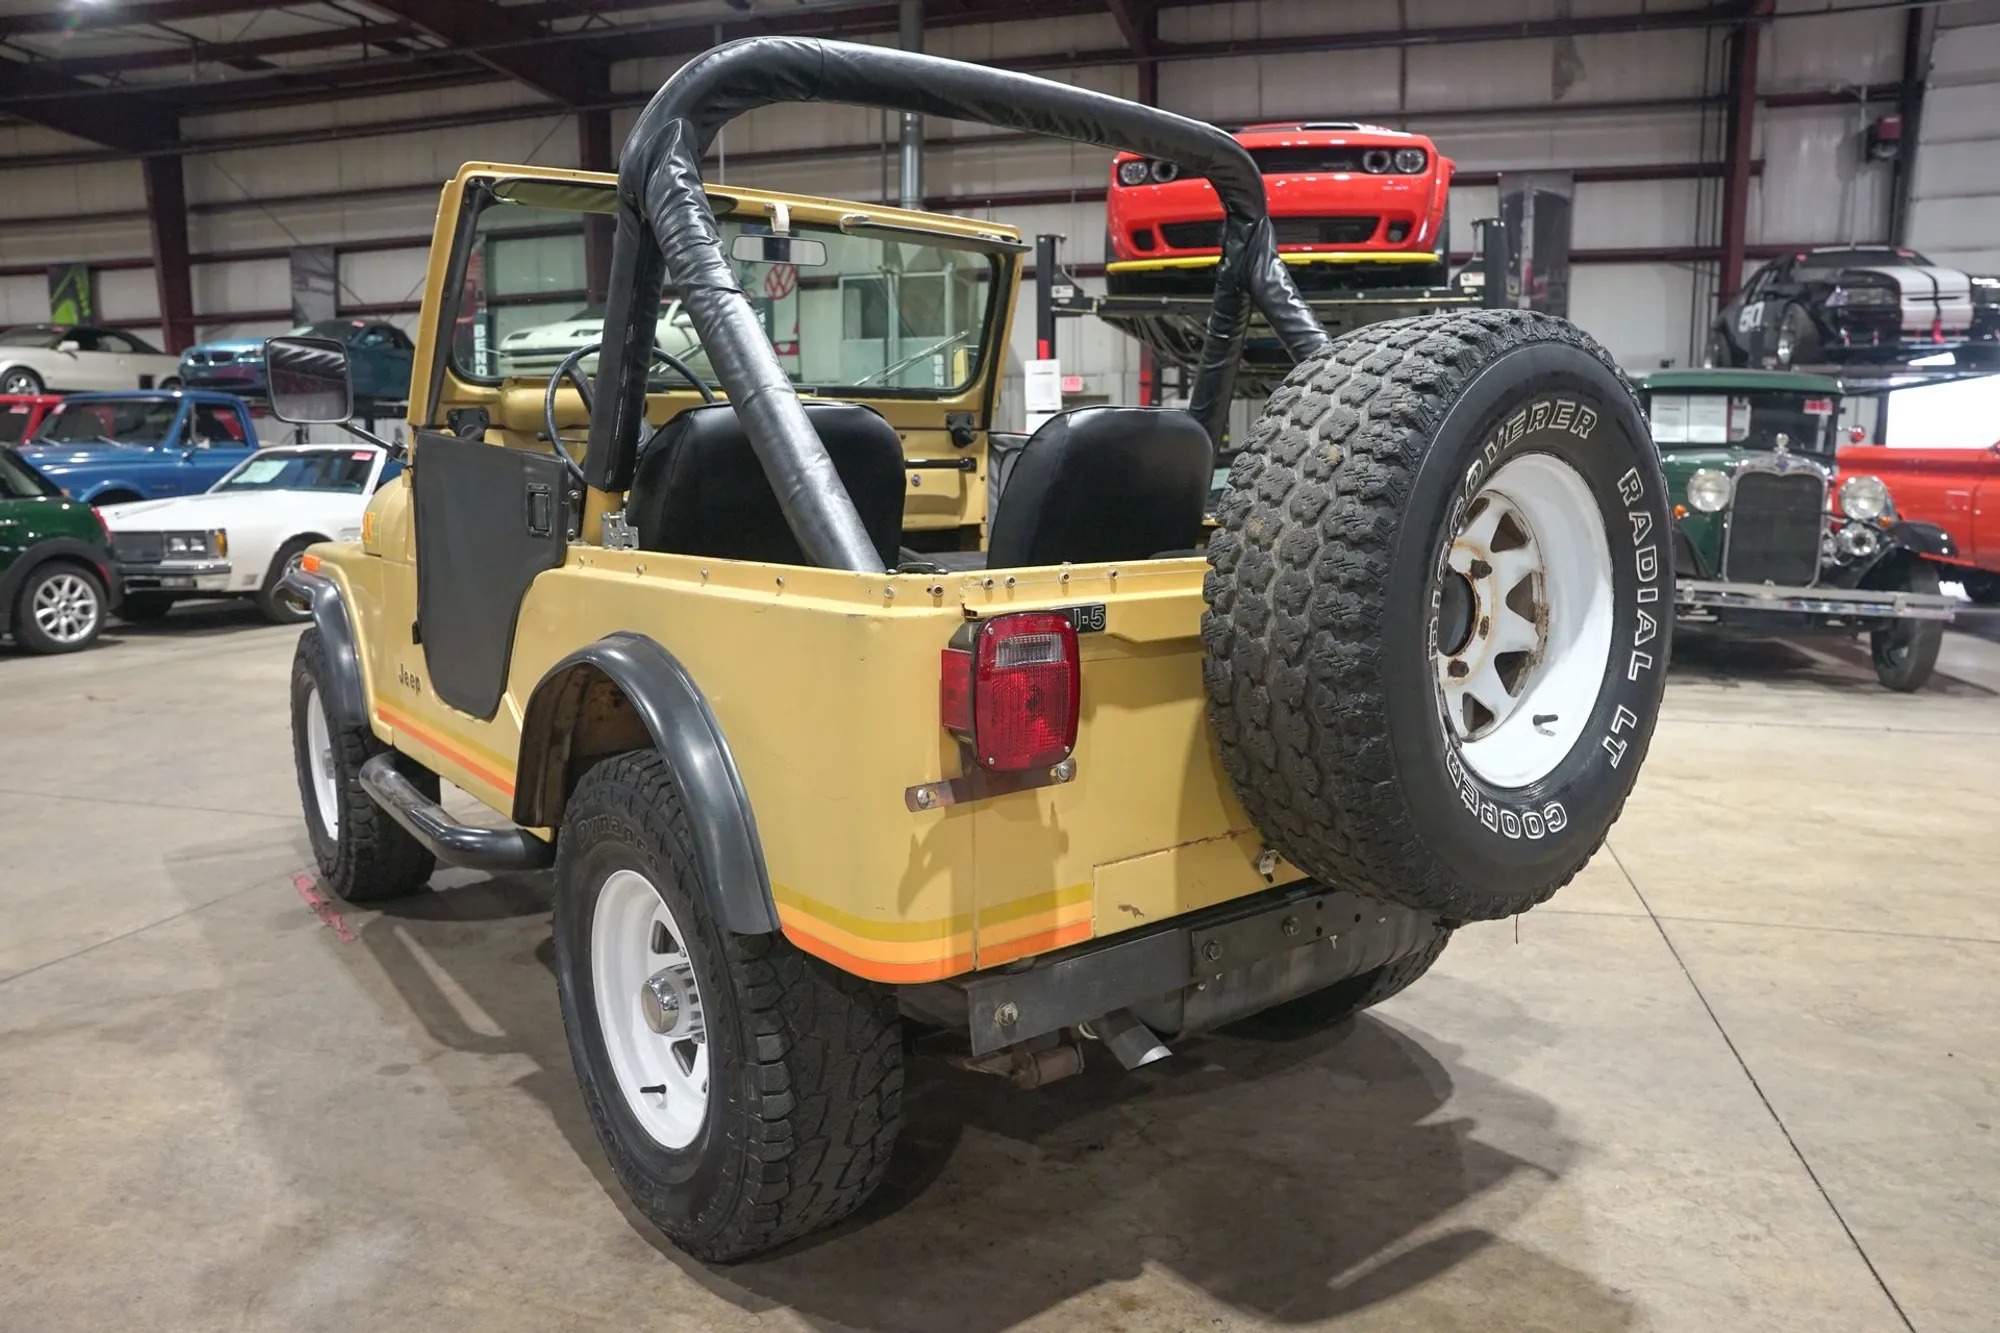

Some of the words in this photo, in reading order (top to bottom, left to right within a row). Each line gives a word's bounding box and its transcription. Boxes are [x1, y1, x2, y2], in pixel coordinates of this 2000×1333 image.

[1617, 467, 1659, 682] RADIAL
[399, 662, 421, 697] Jeep
[1602, 704, 1638, 770] LT
[1446, 748, 1568, 839] COOPER
